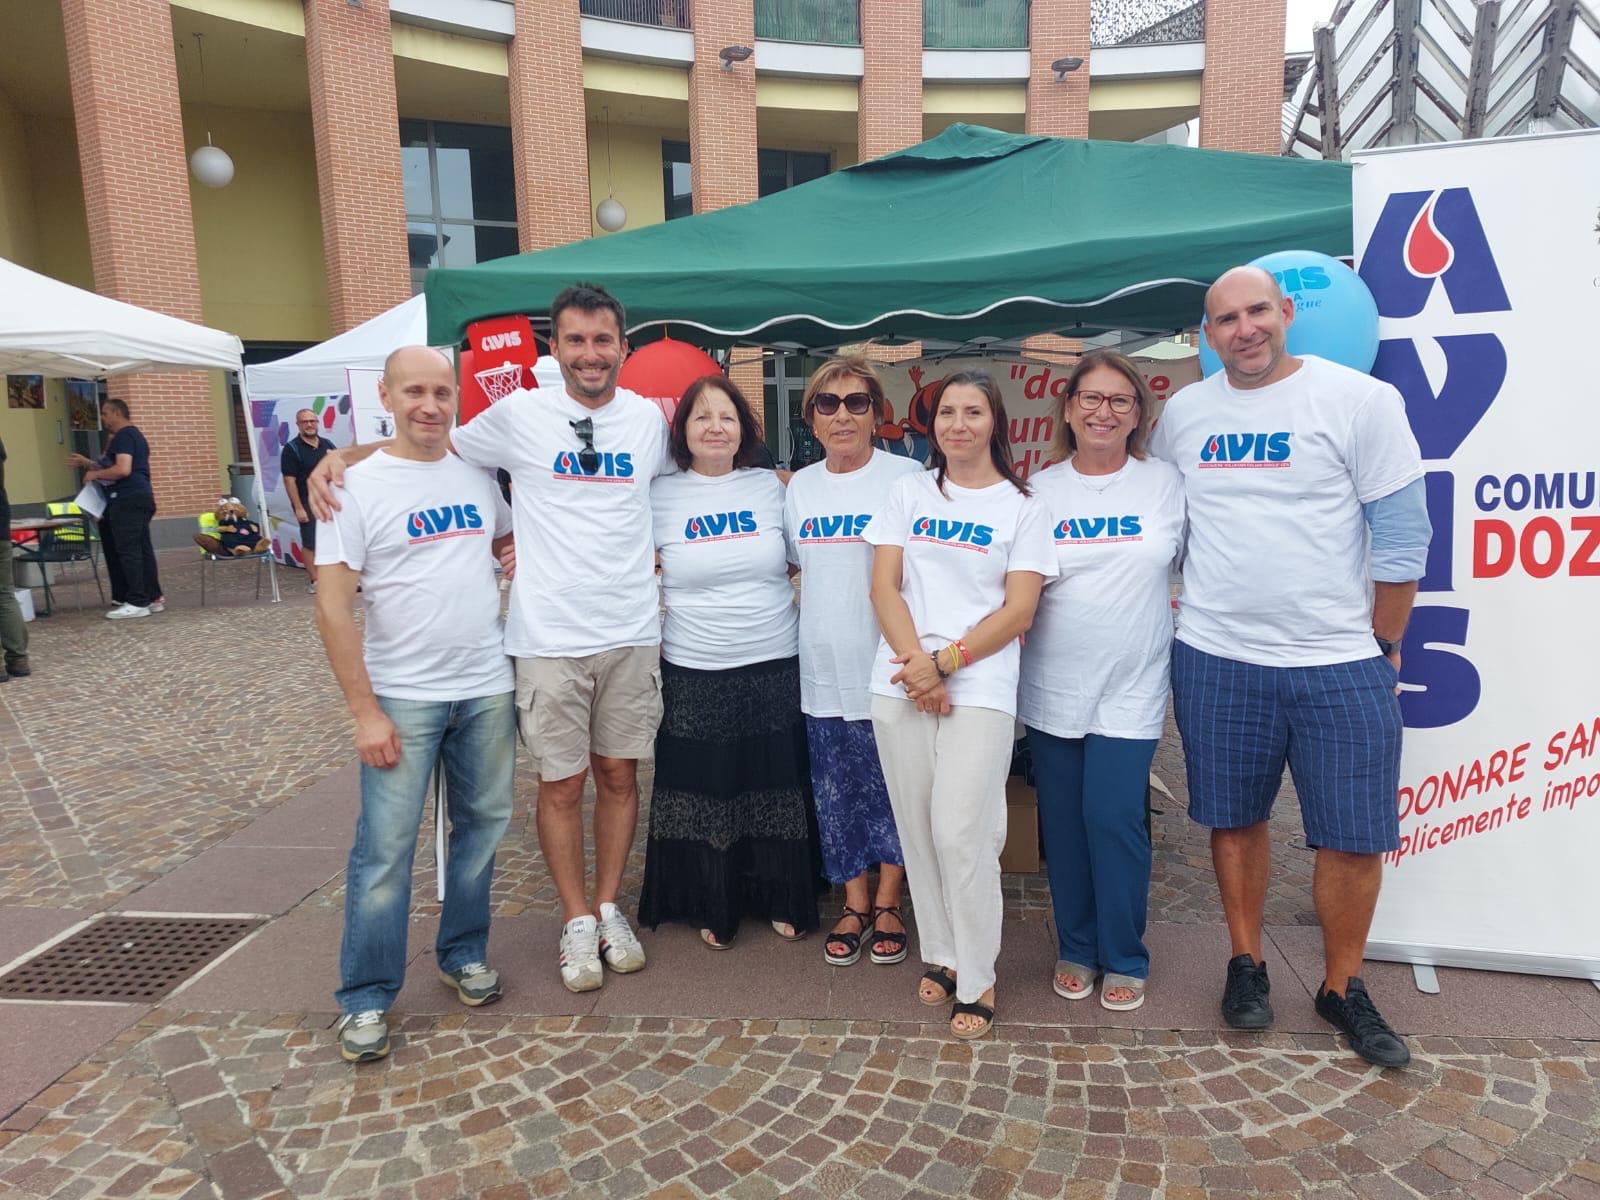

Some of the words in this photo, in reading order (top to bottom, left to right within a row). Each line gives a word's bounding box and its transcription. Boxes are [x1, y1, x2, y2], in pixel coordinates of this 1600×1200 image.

[1273, 266, 1331, 292] IS
[481, 330, 522, 351] AVIS
[1200, 432, 1291, 461] AVIS
[407, 504, 482, 538] AVIS
[685, 510, 757, 540] AVIS
[800, 514, 872, 538] AVIS
[912, 516, 994, 546] AVIS
[1054, 515, 1142, 539] AVIS
[1473, 515, 1600, 579] DOZ
[1397, 742, 1530, 822] DONARE
